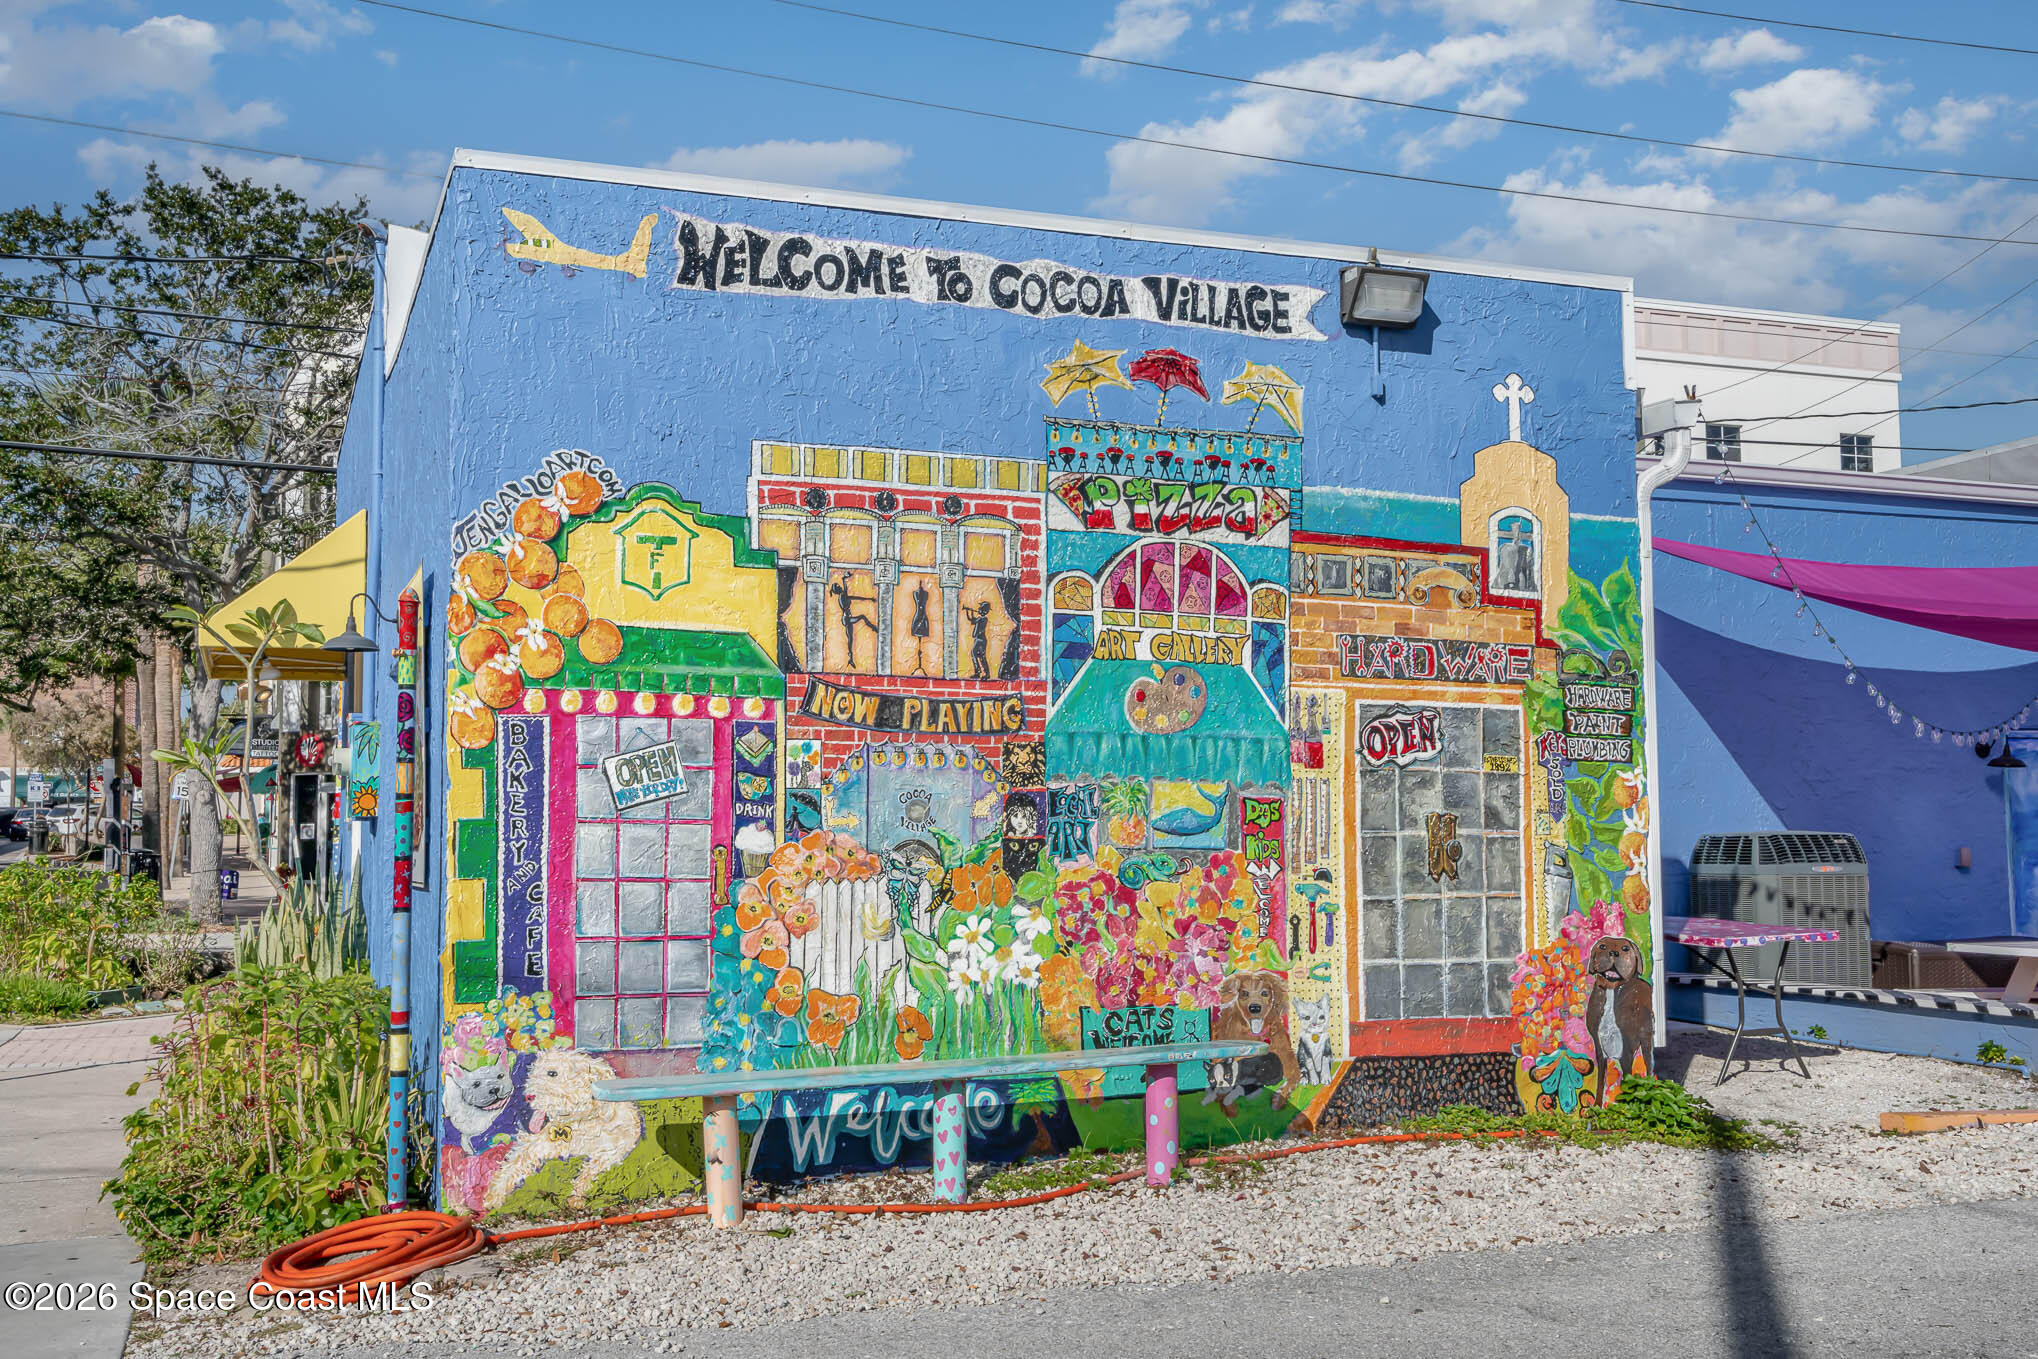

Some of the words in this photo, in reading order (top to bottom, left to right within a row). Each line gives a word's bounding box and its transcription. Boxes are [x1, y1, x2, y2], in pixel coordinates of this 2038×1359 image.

[677, 220, 910, 294] WELCOME
[989, 263, 1130, 317] COCOA
[1092, 628, 1144, 661] ART
[1151, 631, 1250, 666] GALLERY
[1341, 636, 1532, 680] HARDWARE
[811, 683, 881, 726] NOW
[904, 697, 1025, 733] PLAYING
[1565, 685, 1633, 710] HARDWARE
[1366, 712, 1437, 760] OPEN
[1567, 711, 1626, 735] PAINT
[1567, 737, 1632, 760] PLUMBING
[615, 746, 679, 787] OPEN
[1548, 757, 1563, 800] SOLD
[177, 786, 189, 796] 15
[507, 721, 533, 865] BAKERY
[898, 789, 932, 804] COCOA
[735, 802, 774, 818] DRINK
[900, 815, 936, 832] VILLAGE
[507, 861, 538, 895] AND
[525, 881, 544, 977] CAFE
[1102, 1008, 1174, 1036] CATS
[555, 1128, 569, 1139] M
